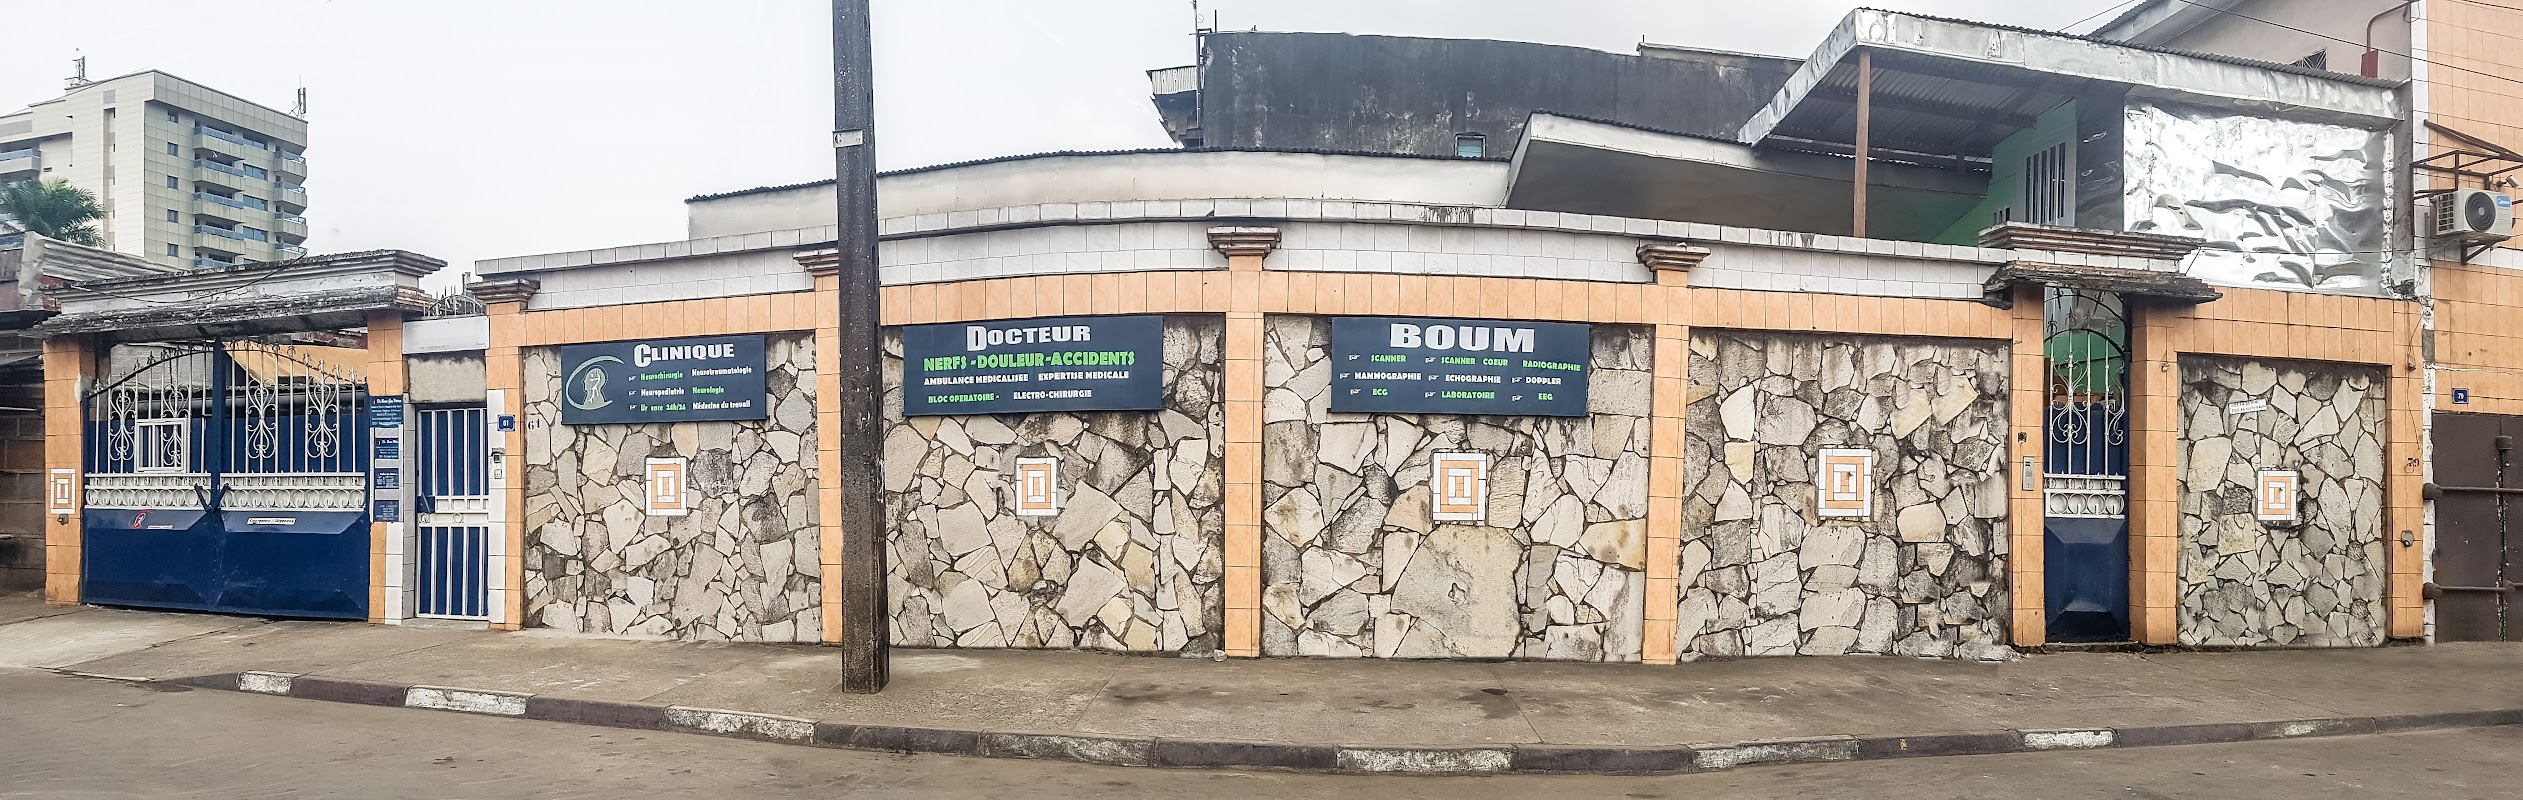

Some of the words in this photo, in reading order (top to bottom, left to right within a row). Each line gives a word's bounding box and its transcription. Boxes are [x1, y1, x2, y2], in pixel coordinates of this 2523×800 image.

[967, 326, 1091, 351] DOCTEUR
[1390, 323, 1535, 353] BOUM
[634, 343, 735, 368] CLINIQUE
[923, 356, 967, 371] NERFS
[1441, 357, 1476, 365] SCANNER
[1483, 358, 1509, 366] COEUR
[1523, 360, 1581, 371] RADIOGRAPHIE
[640, 371, 684, 381] Neurochirurgie
[691, 366, 752, 377] Neurotraumatologie
[1038, 371, 1084, 381] EXPERTISE
[1085, 371, 1130, 379] MEDICALE
[1354, 372, 1422, 381] MAMMOGRAPHIE
[924, 376, 974, 386] AMBULANCE
[976, 373, 1029, 384] MEDICALISEE
[1445, 375, 1501, 384] ECHOGRAPHIE
[1525, 376, 1562, 385] DOPPLER
[640, 387, 685, 397] Neuropediatrie
[692, 386, 725, 395] Neurologie
[1013, 390, 1092, 400] ELECTRO-CHIRURGIE
[1372, 388, 1388, 396] ECG
[1441, 391, 1495, 399] LABORATOIRE
[928, 395, 948, 403] BLOC
[949, 393, 995, 402] OPERATOIRE
[665, 403, 687, 411] 24h/24
[692, 401, 719, 410] Médecine
[720, 400, 729, 408] du
[730, 399, 751, 408] travail
[528, 418, 540, 429] 61
